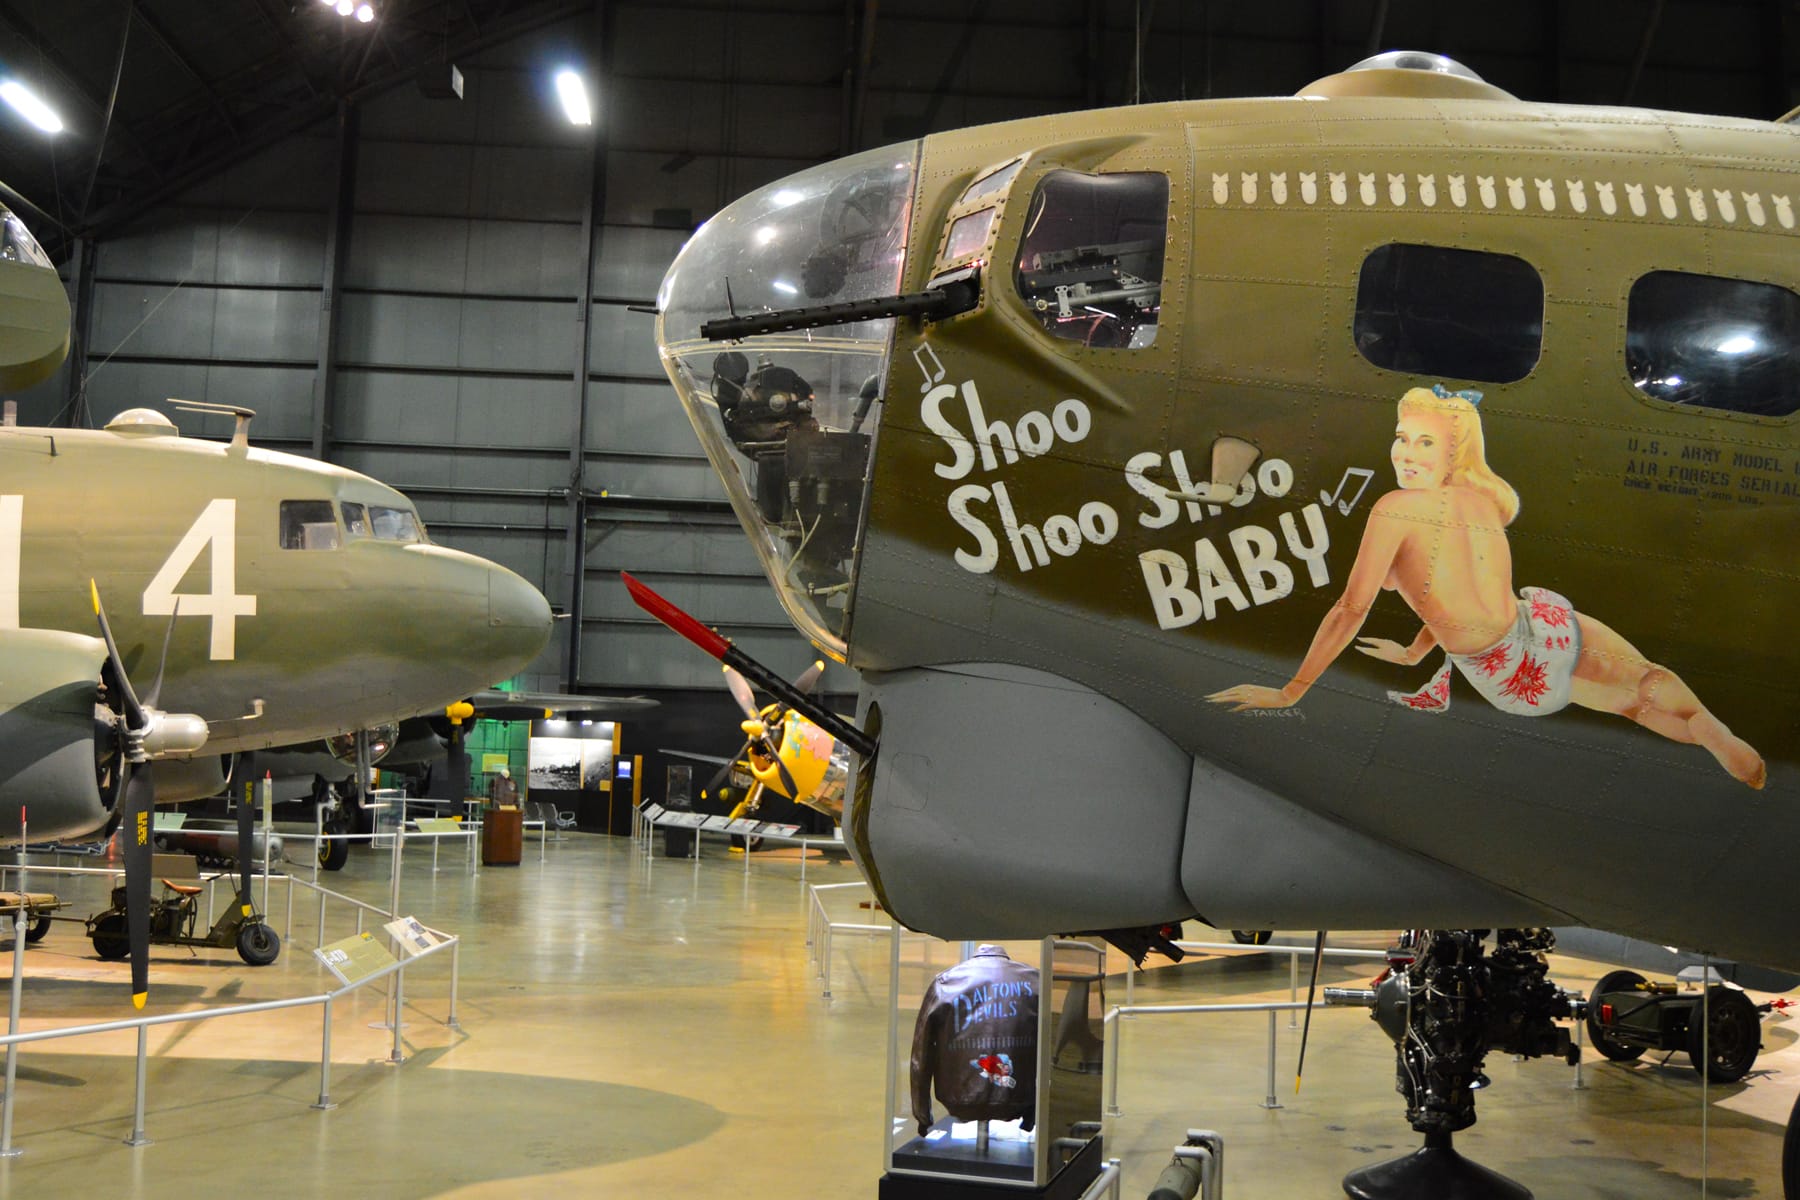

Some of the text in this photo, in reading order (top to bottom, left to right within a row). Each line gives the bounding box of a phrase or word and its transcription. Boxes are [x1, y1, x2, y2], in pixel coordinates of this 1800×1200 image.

[920, 379, 1092, 480] Shoo
[1626, 459, 1658, 476] AIR
[1668, 465, 1730, 487] FORCES
[1681, 445, 1722, 463] ARMY
[1733, 453, 1784, 473] MODEL
[947, 481, 1119, 574] Shoo
[1139, 503, 1330, 630] BABY
